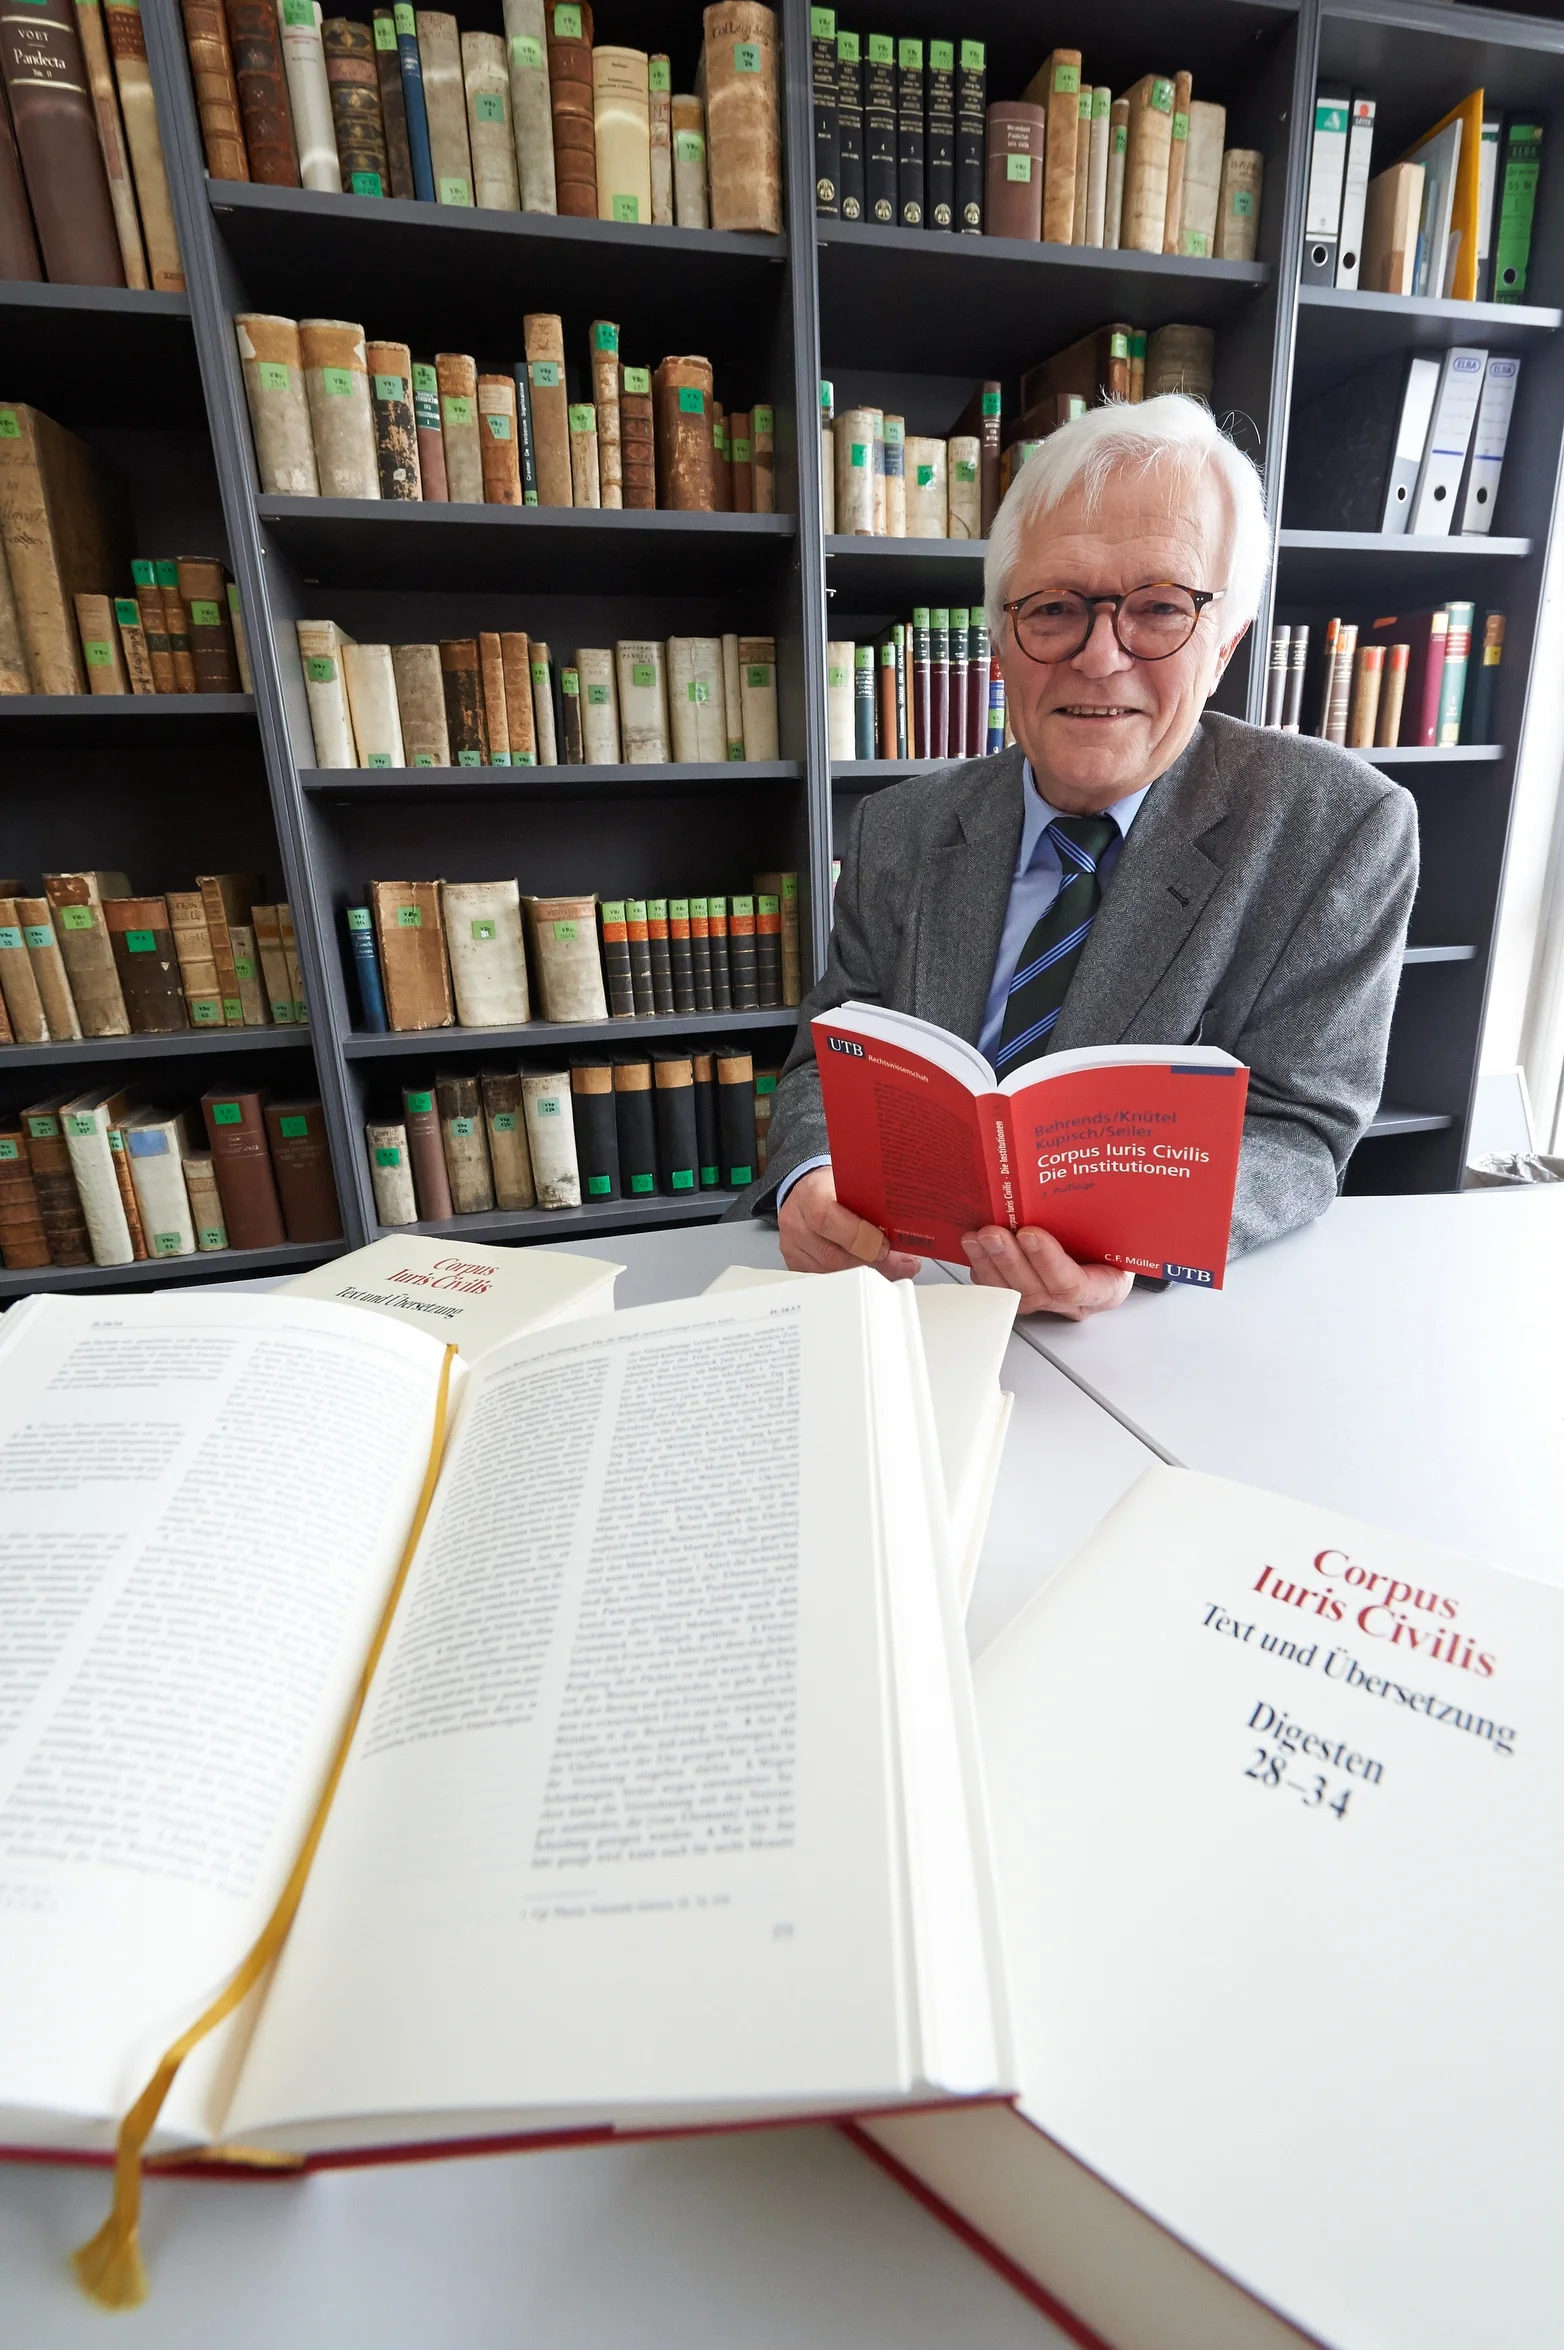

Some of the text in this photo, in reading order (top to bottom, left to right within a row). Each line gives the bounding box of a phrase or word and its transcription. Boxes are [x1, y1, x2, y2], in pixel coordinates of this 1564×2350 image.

[1456, 360, 1477, 369] ELBA
[829, 1037, 929, 1083] UTB Rechtswissenschaft
[1034, 1110, 1177, 1138] Behrends/Knütel
[996, 1120, 1009, 1163] Institutionen
[1035, 1125, 1153, 1151] Kupisch/Seiler
[1000, 1163, 1010, 1175] Die
[1037, 1143, 1210, 1168] Corpus Iuris Civilis
[1039, 1159, 1191, 1184] Die Institutionen
[1002, 1181, 1013, 1200] Civilis
[433, 1257, 500, 1277] Corpus
[1104, 1253, 1160, 1270] C.F. Müller
[1165, 1263, 1211, 1283] UTB
[384, 1268, 493, 1295] Iuris Civilis
[335, 1285, 465, 1320] Text und Übersetzung
[1313, 1548, 1460, 1620] Corpus
[1251, 1564, 1497, 1678] Iuris Civilis
[1202, 1601, 1518, 1757] Text und Übersetzung
[1246, 1700, 1386, 1785] Digesten
[1243, 1747, 1353, 1821] 28–34
